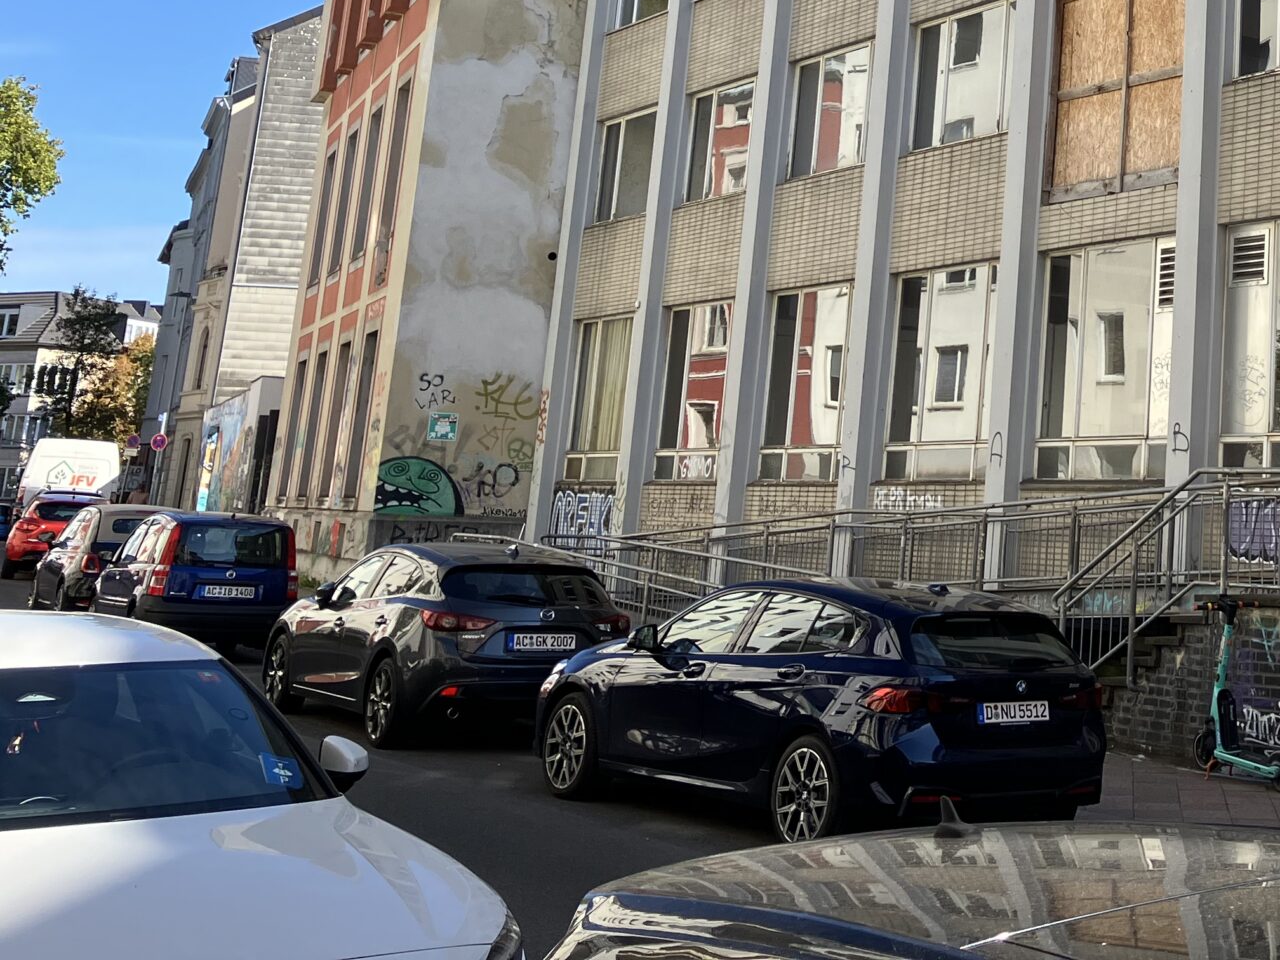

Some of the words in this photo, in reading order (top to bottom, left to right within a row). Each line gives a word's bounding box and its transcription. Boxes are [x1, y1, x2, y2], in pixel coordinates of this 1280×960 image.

[419, 373, 445, 391] SO
[69, 475, 97, 486] JFV
[207, 586, 217, 596] AC
[515, 634, 528, 648] AC
[536, 635, 549, 648] GK
[550, 635, 574, 648] 2007
[985, 704, 993, 721] D
[1001, 704, 1016, 719] NU
[1019, 703, 1047, 719] 5512
